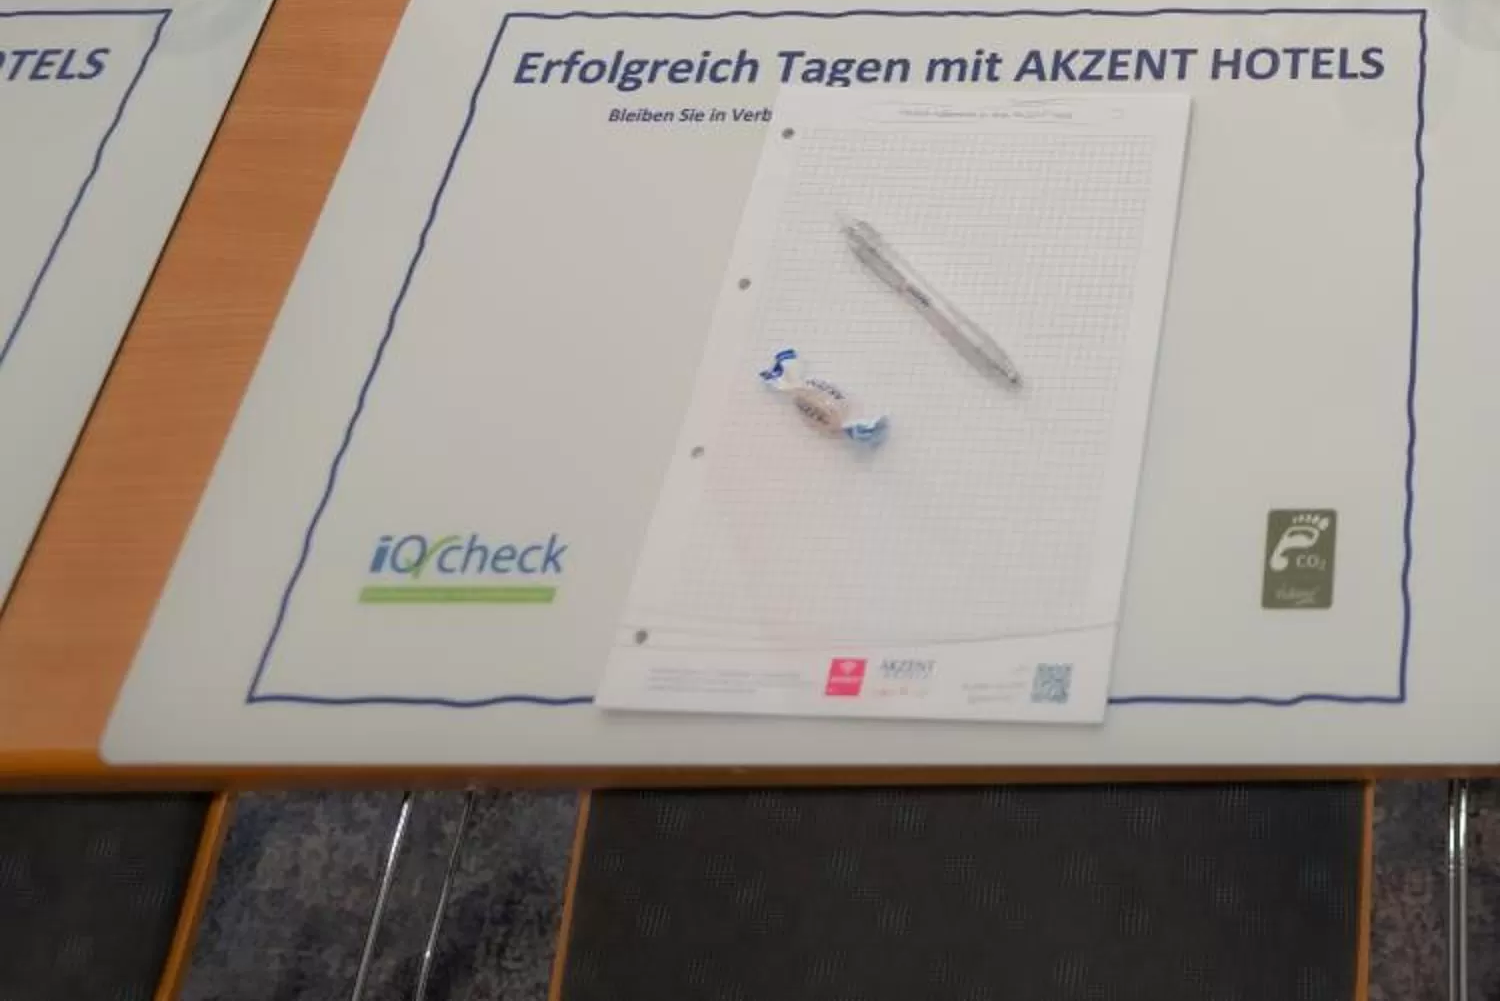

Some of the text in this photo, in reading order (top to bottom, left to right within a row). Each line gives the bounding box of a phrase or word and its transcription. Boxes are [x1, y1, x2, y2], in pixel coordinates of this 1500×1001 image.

[0, 48, 110, 81] TELS
[513, 46, 1387, 92] Erfolgreich Tagen mit AKZENT HOTELS
[608, 108, 675, 122] Bleiben
[679, 108, 705, 122] Sie
[709, 108, 727, 122] in
